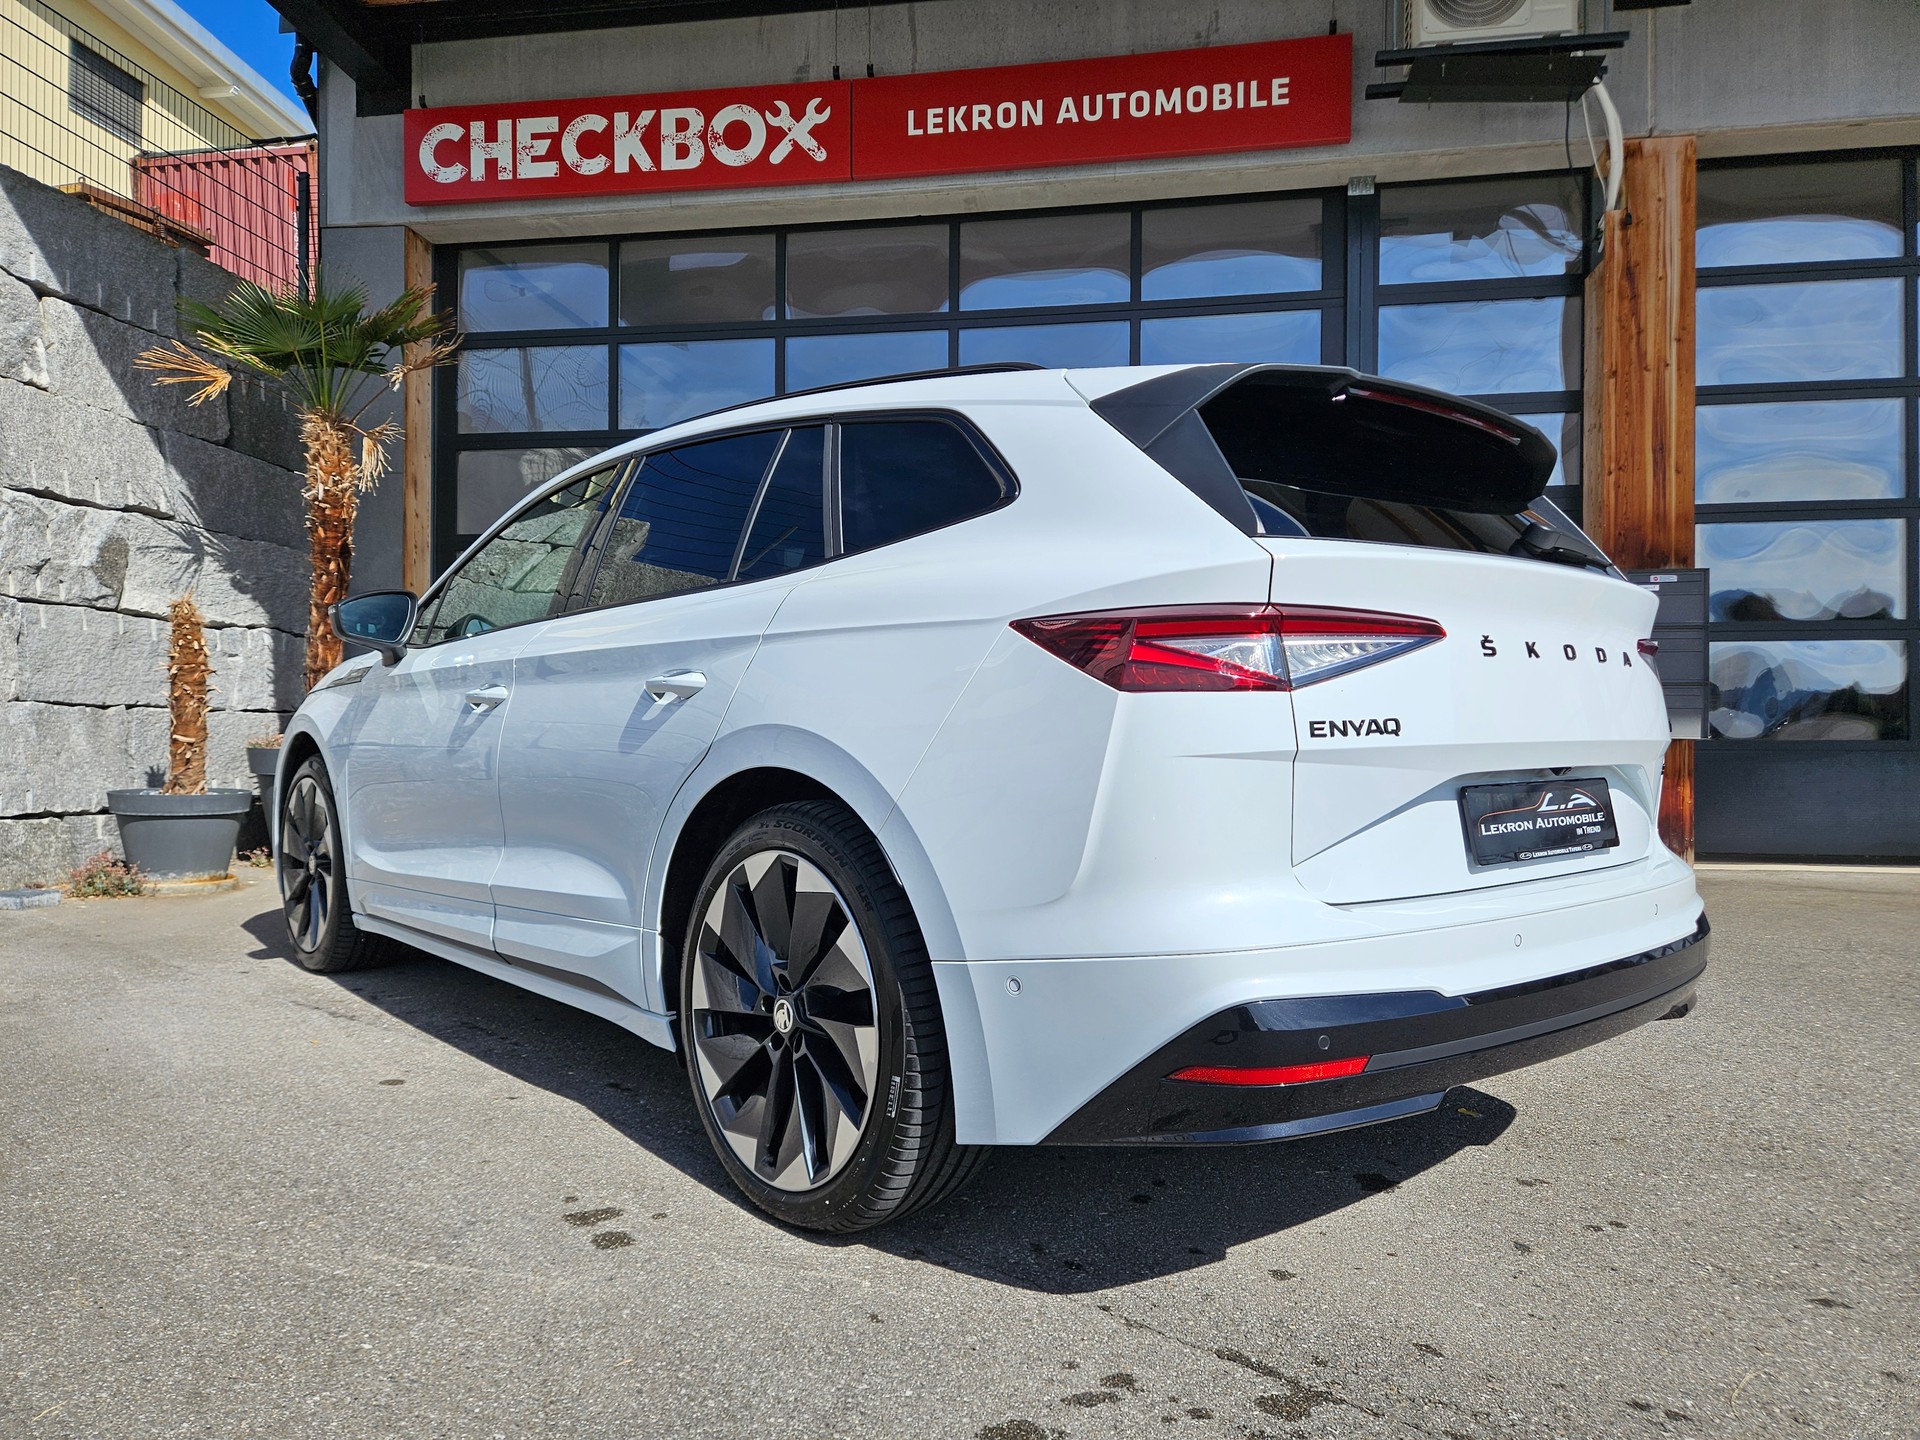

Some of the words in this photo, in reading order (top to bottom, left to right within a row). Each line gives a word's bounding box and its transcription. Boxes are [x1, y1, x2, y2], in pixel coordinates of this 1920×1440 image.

[907, 99, 1044, 136] LEKRON
[1056, 77, 1291, 124] AUTOMOBILE
[418, 97, 831, 184] CHECKBOX
[1308, 717, 1402, 738] ENYAQ
[773, 819, 849, 869] SCORPION
[1481, 821, 1533, 836] LEKRON
[1536, 812, 1605, 829] AUTOMOBILE
